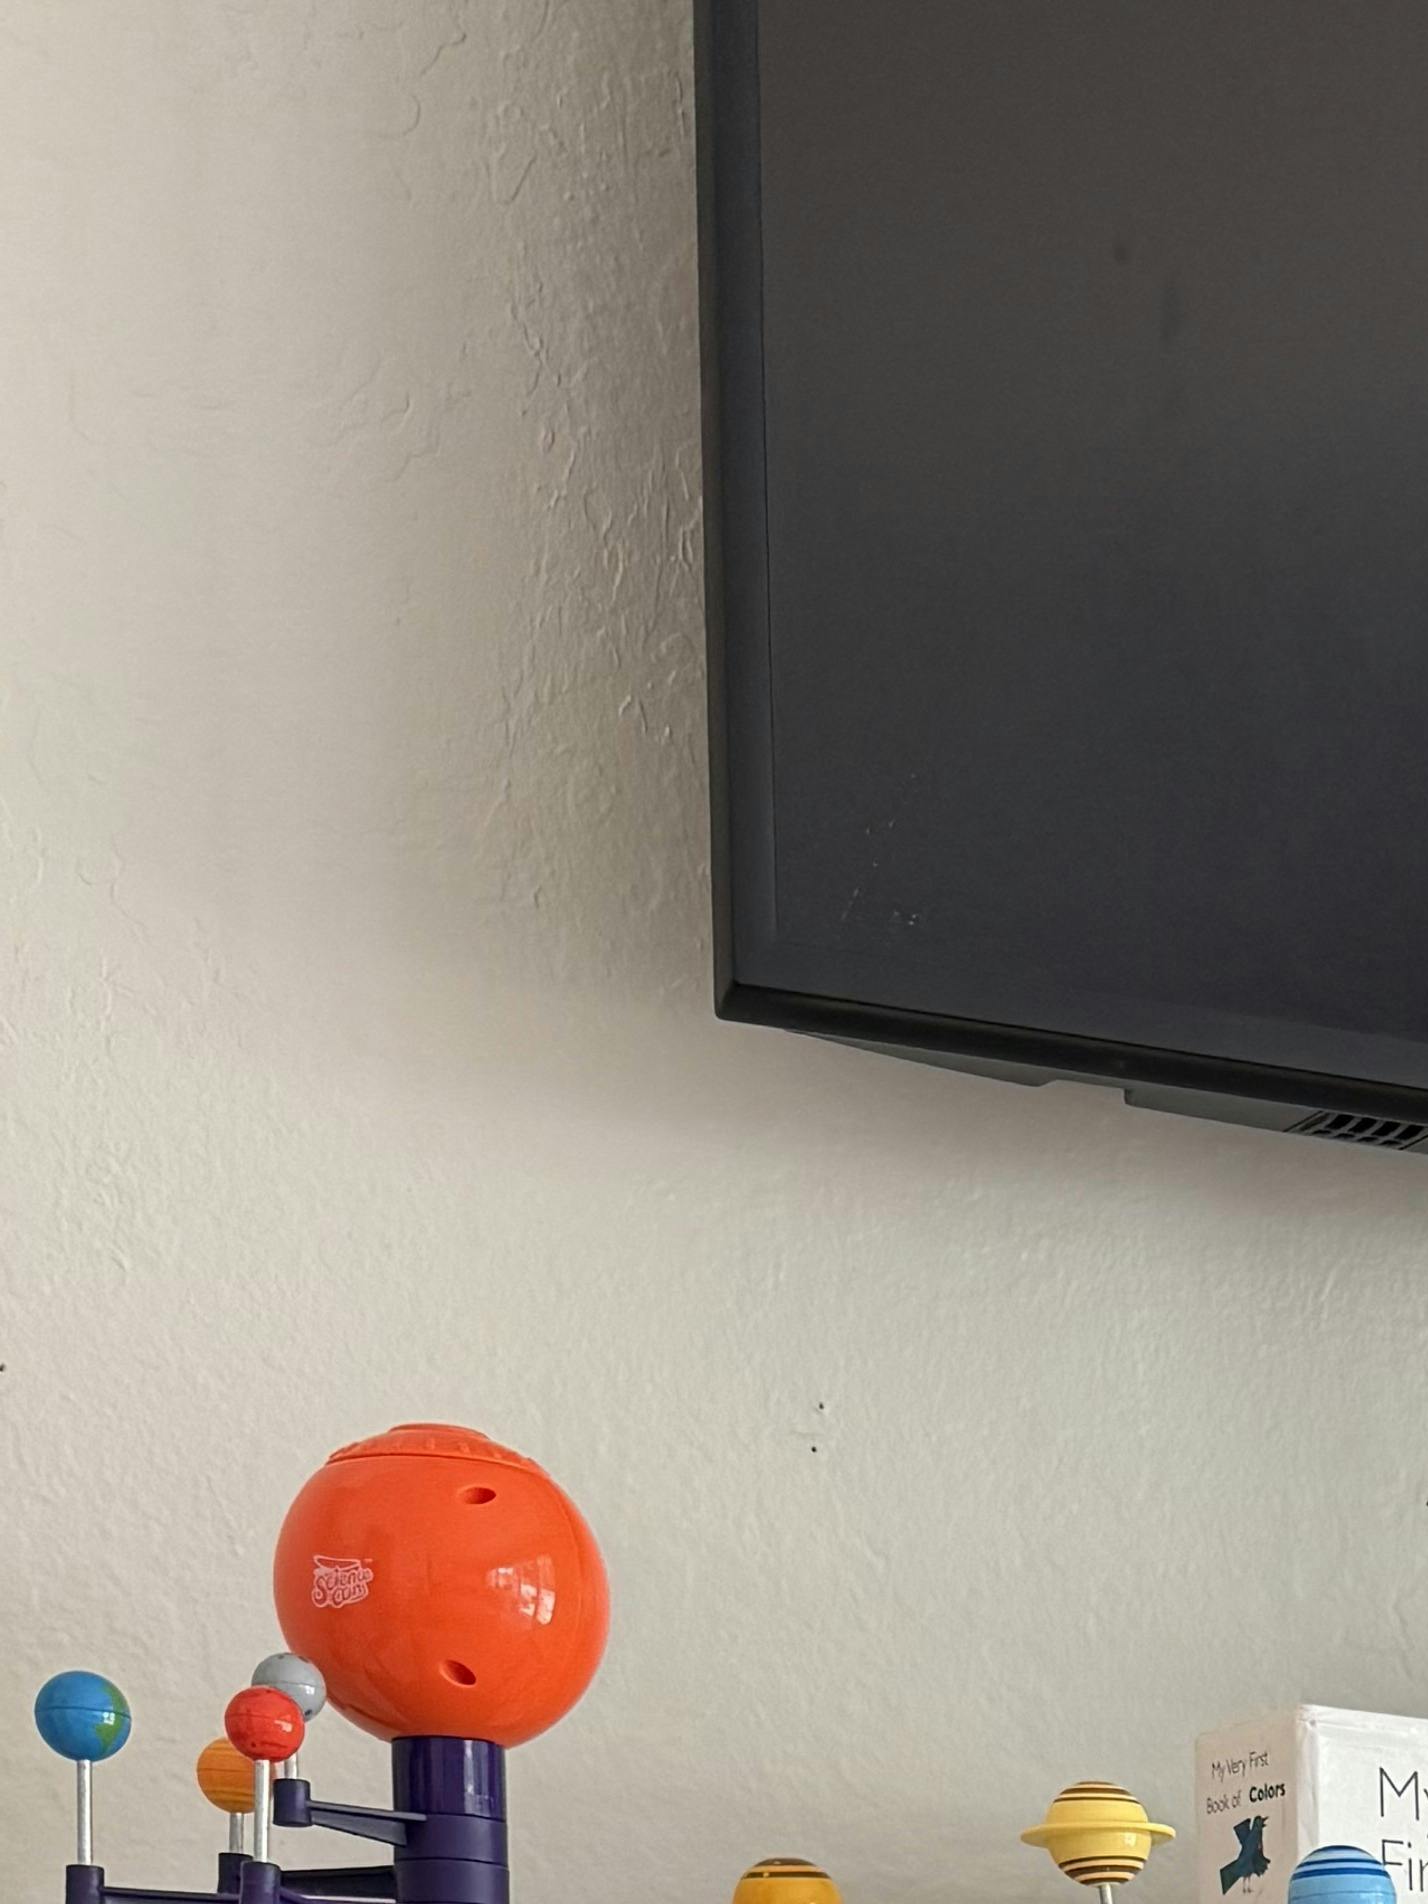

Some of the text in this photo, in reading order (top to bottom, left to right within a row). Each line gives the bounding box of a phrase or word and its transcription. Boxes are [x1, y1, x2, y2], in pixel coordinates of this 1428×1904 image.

[1211, 1751, 1270, 1782] My Very First
[1206, 1781, 1286, 1814] Book of Colors
